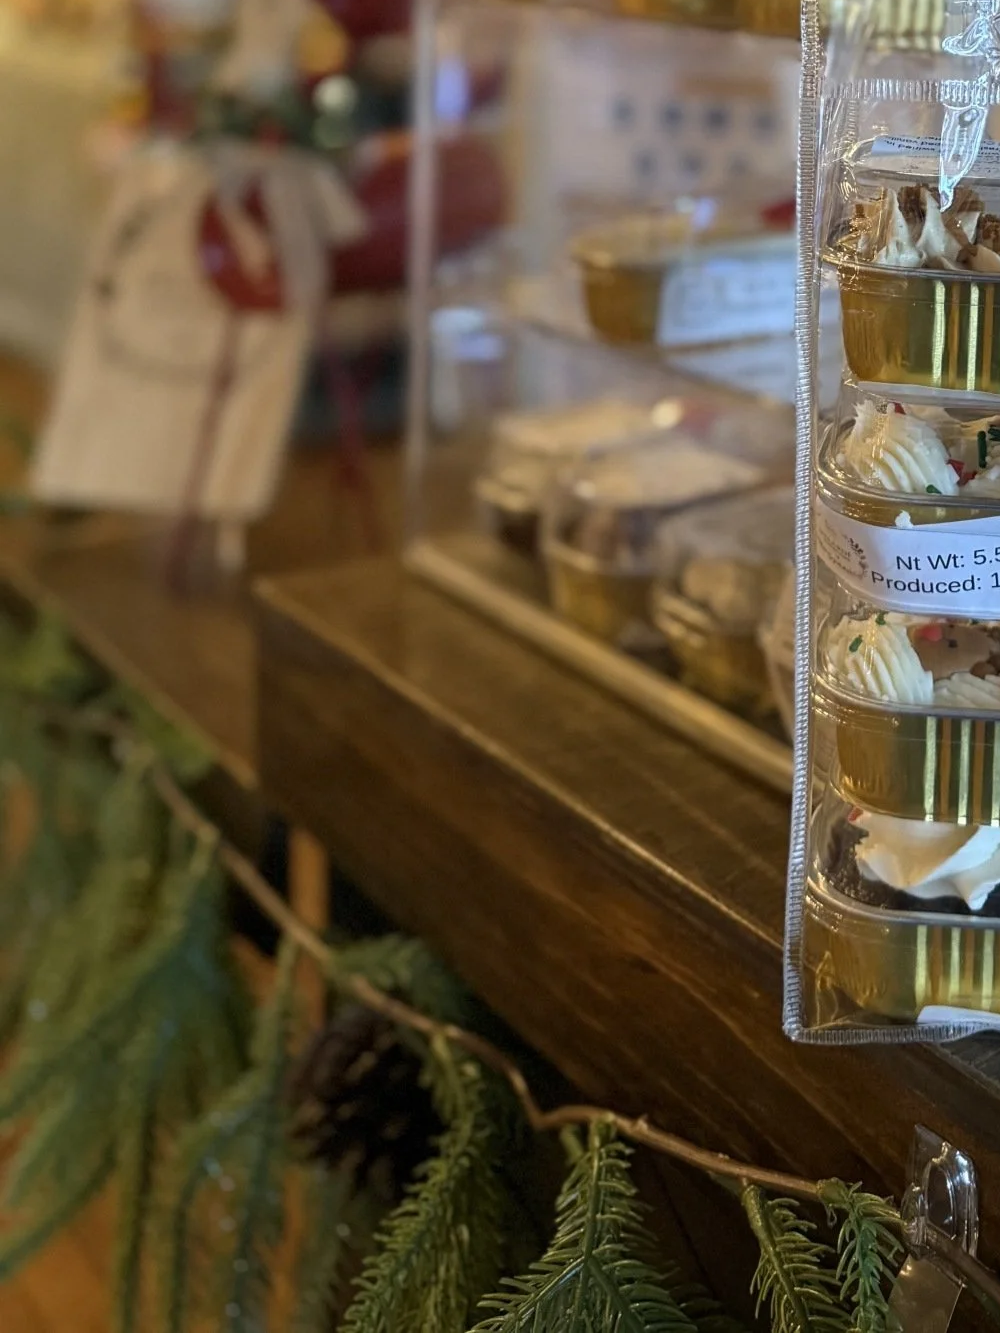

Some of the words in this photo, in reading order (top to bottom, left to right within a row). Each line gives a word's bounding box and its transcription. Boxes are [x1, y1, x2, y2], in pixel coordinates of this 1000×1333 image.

[896, 555, 921, 571] Nt
[926, 552, 965, 570] Wt:
[871, 570, 982, 594] Produced:
